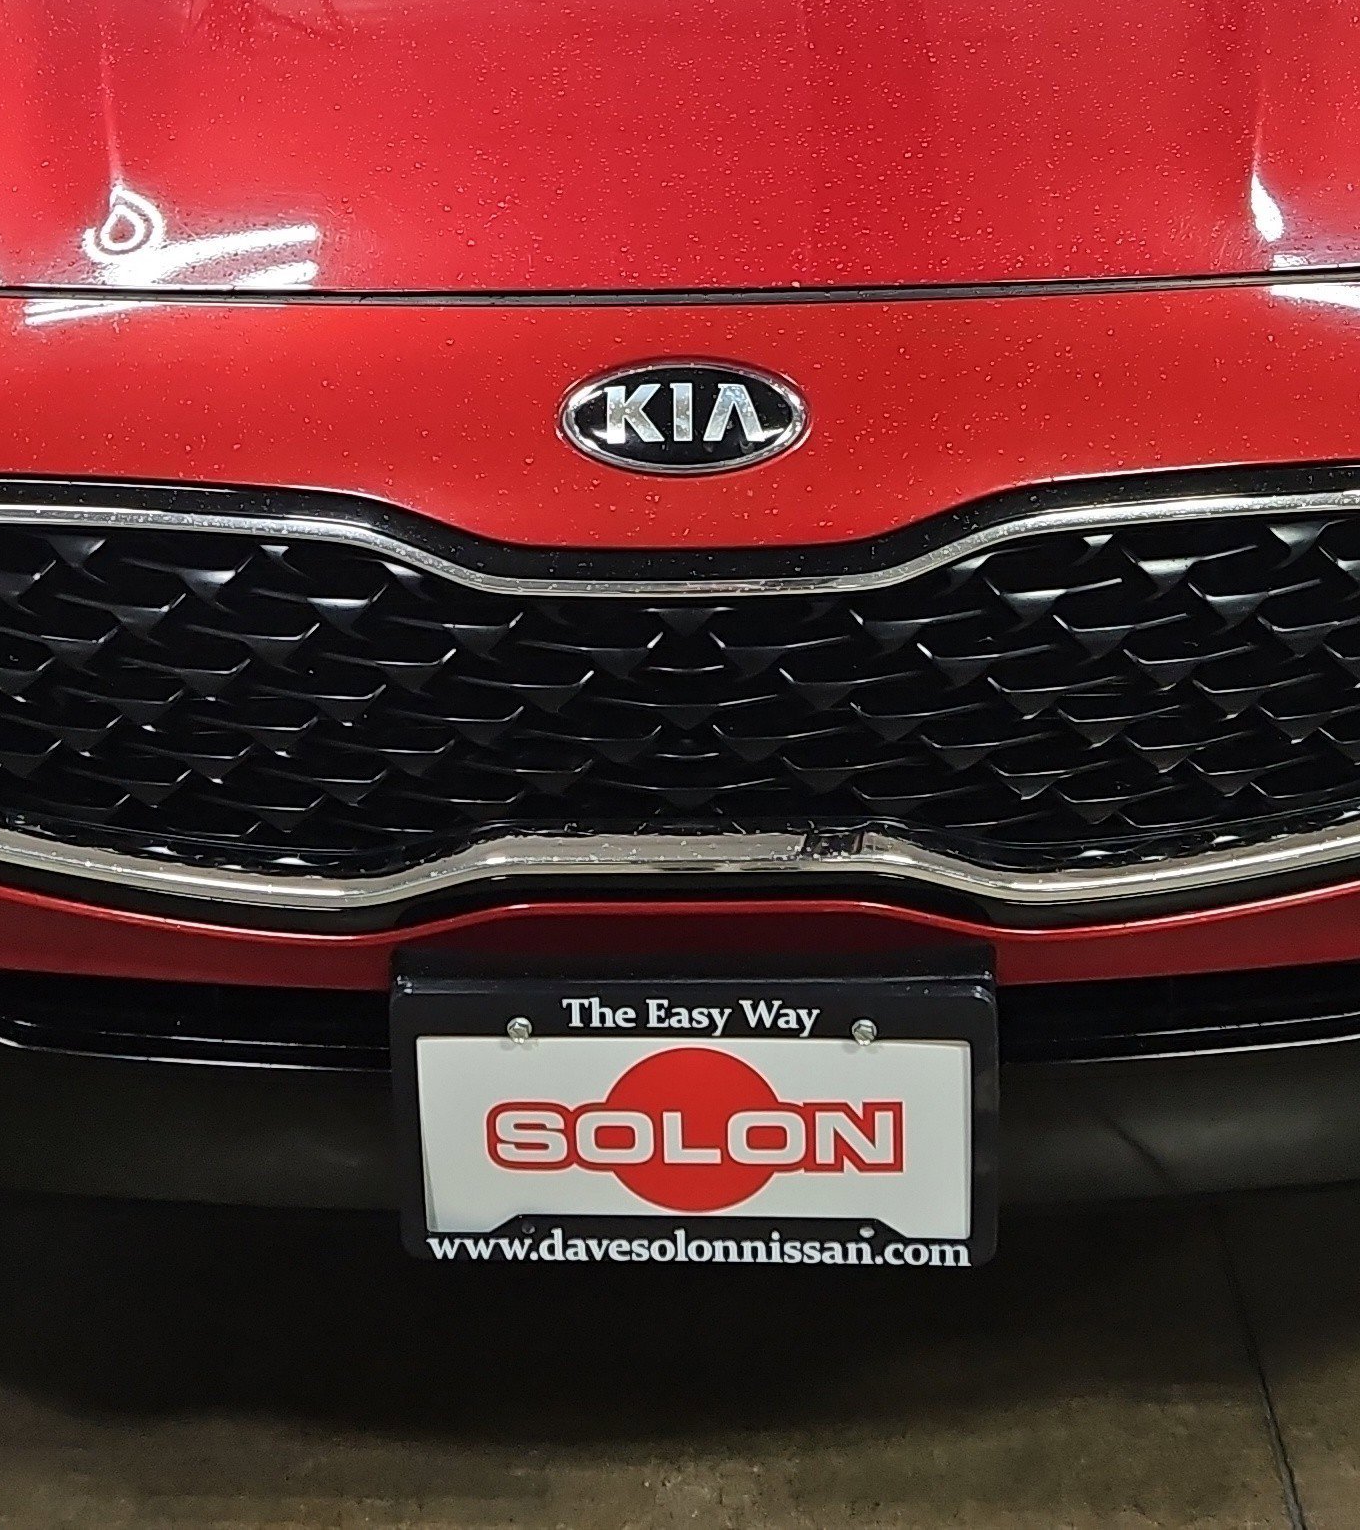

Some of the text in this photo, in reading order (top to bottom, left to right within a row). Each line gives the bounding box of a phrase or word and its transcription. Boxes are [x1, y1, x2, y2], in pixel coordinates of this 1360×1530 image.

[603, 382, 766, 445] KIA
[562, 996, 821, 1038] The Easy Way
[486, 1100, 905, 1173] SOLON
[426, 1228, 972, 1268] www.davesolonnissan.com
